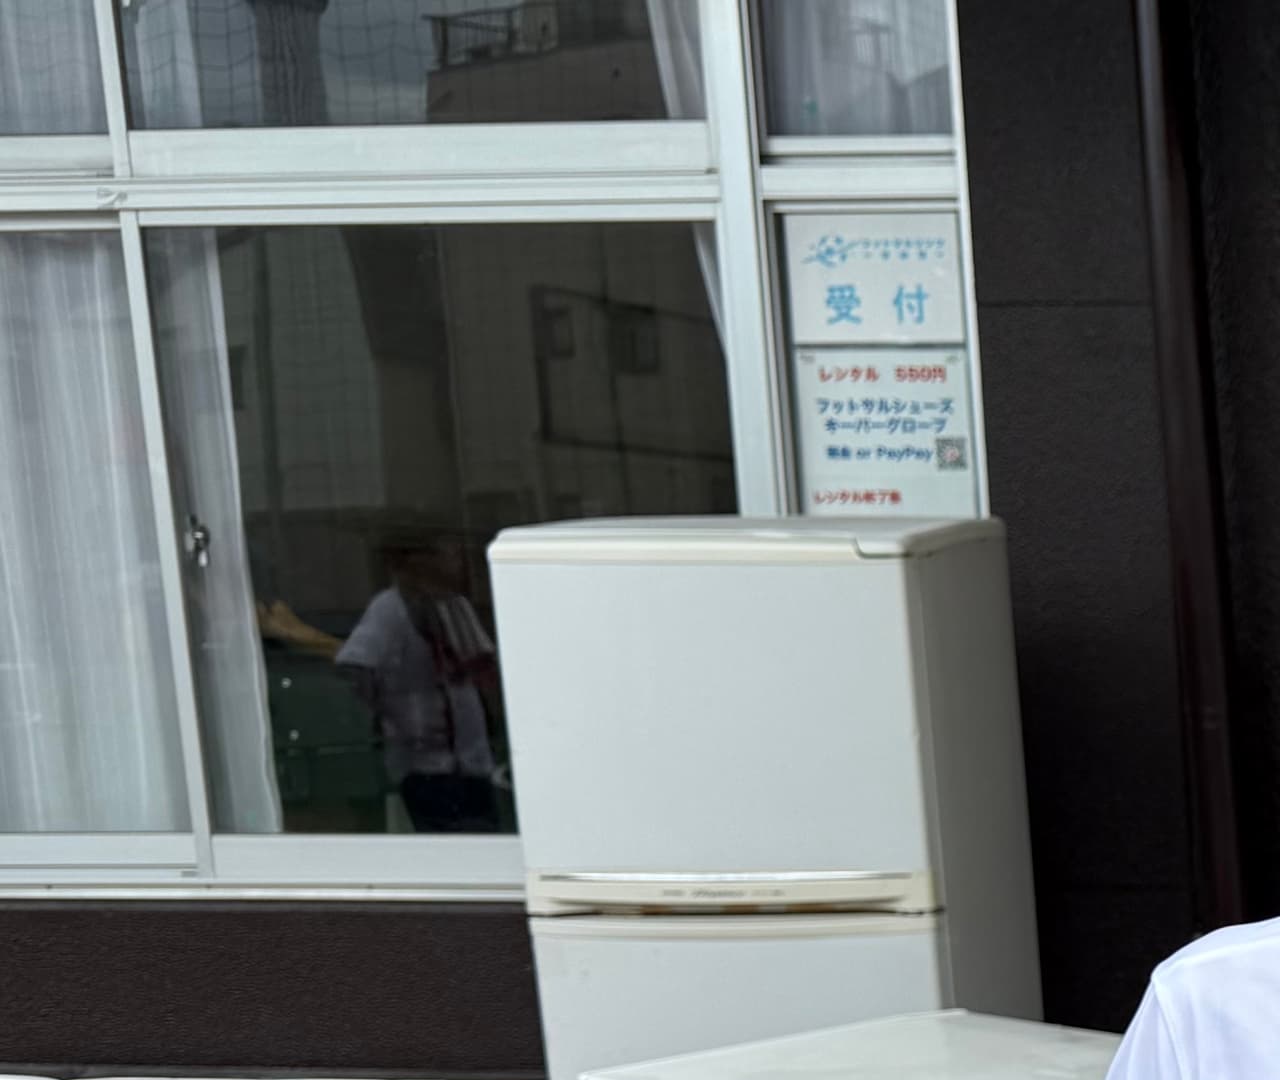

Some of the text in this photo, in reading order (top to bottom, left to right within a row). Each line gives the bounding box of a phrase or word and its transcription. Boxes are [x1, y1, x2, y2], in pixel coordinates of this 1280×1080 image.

[826, 284, 929, 325] 受付
[818, 365, 880, 383] レンタル
[816, 398, 954, 415] フットサルシューズ
[825, 417, 947, 434] キーパーグローブ
[877, 445, 933, 462] PayPay
